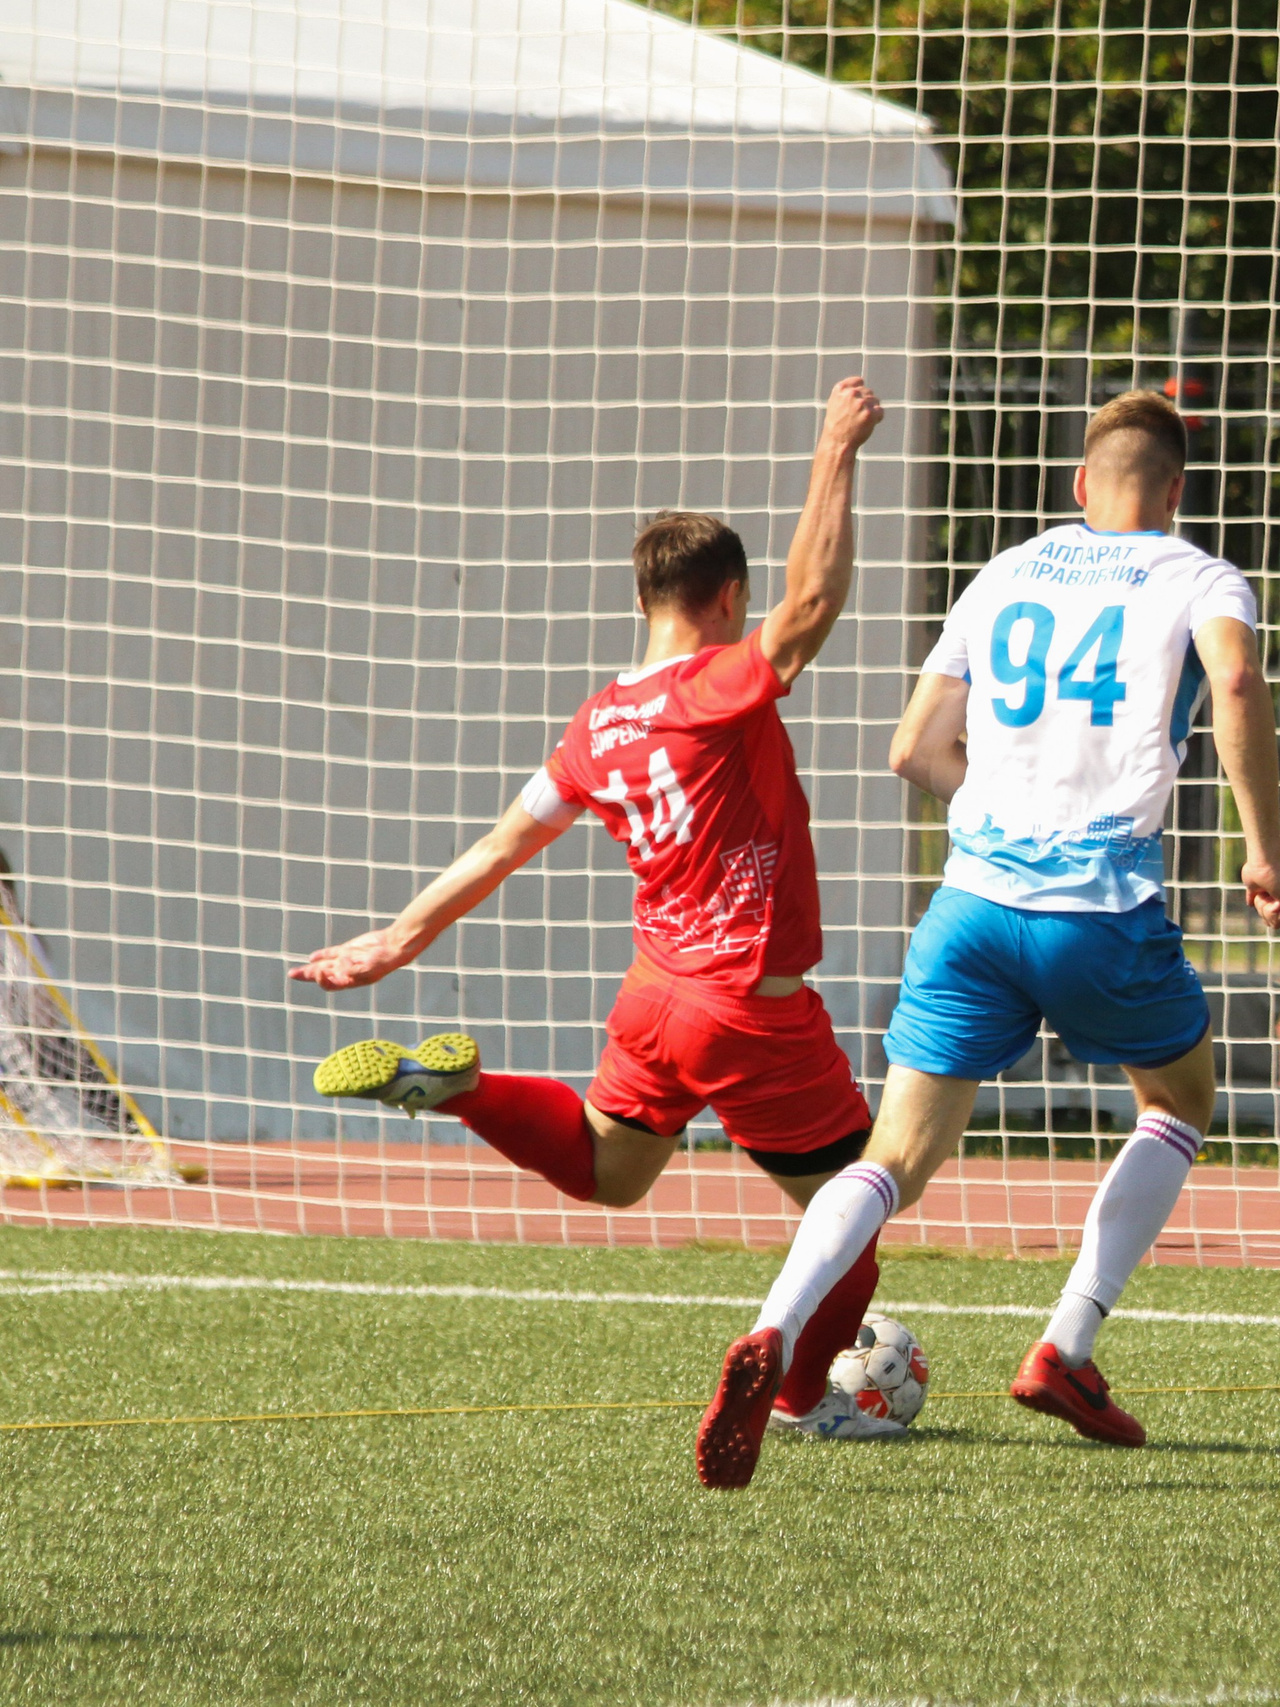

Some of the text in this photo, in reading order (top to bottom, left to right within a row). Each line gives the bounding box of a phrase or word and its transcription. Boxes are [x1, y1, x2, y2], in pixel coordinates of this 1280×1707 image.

[1038, 541, 1138, 566] АППАРАТ
[990, 601, 1127, 729] 94
[590, 746, 695, 862] 14
